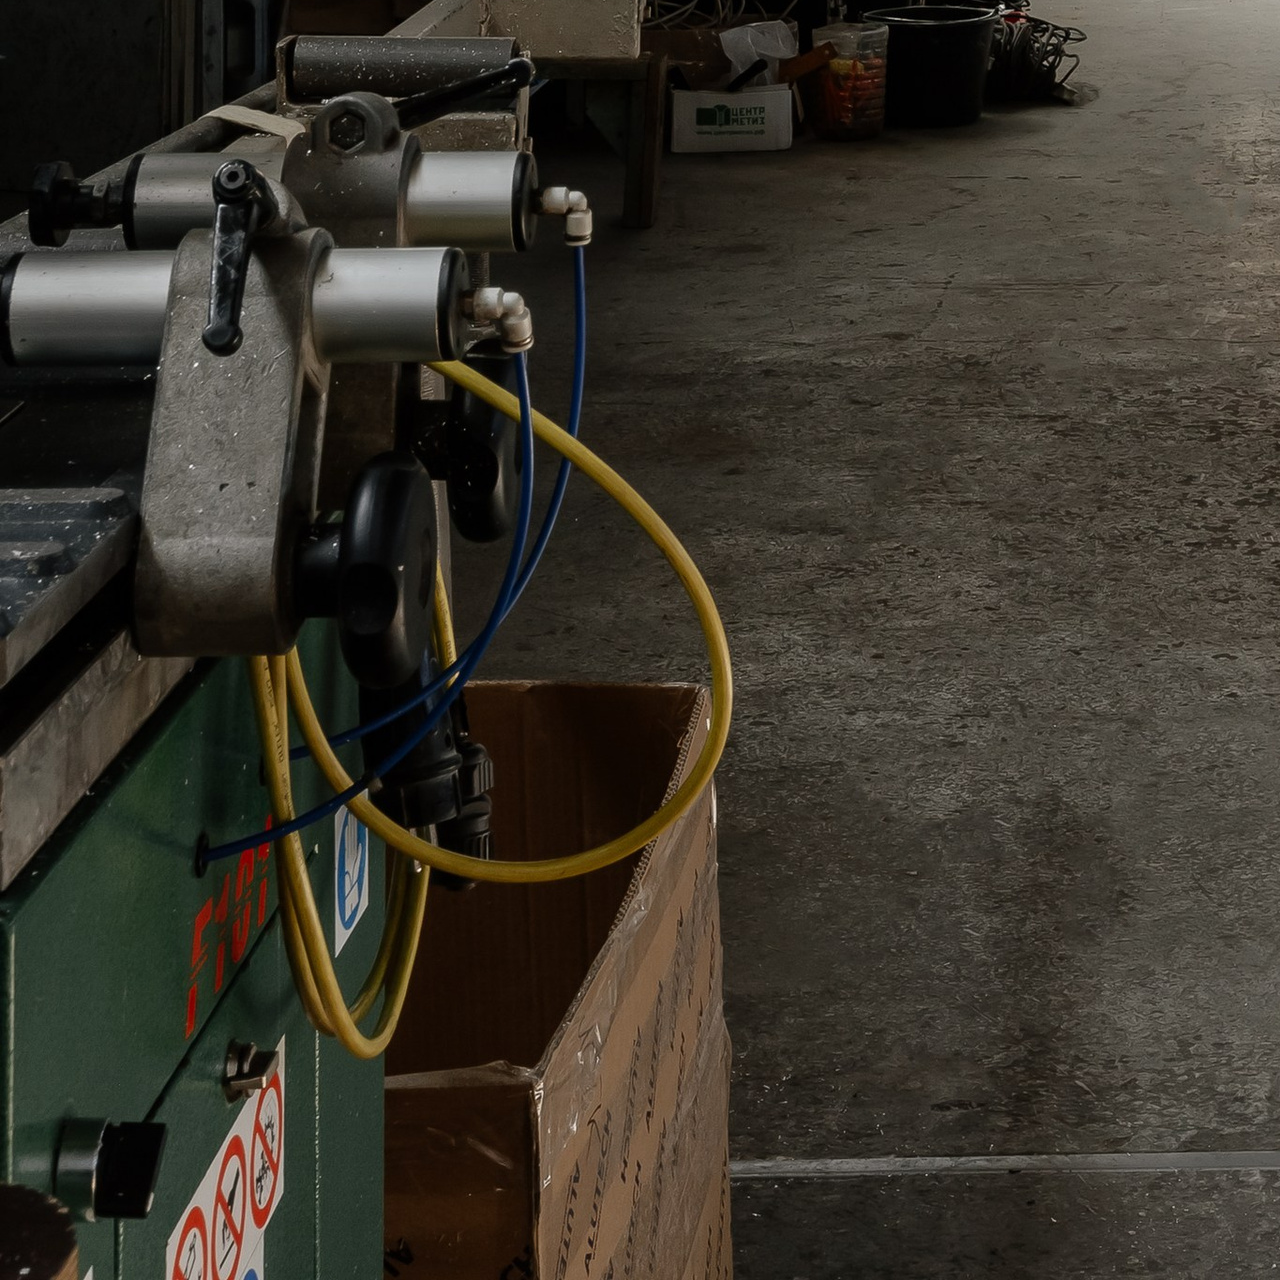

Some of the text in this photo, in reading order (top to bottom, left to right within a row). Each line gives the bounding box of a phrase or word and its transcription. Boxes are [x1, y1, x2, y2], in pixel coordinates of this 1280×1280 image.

[731, 106, 765, 117] ЦЕНТР
[731, 117, 765, 126] МЕТИЗ
[584, 1109, 612, 1277] ALUTECH
